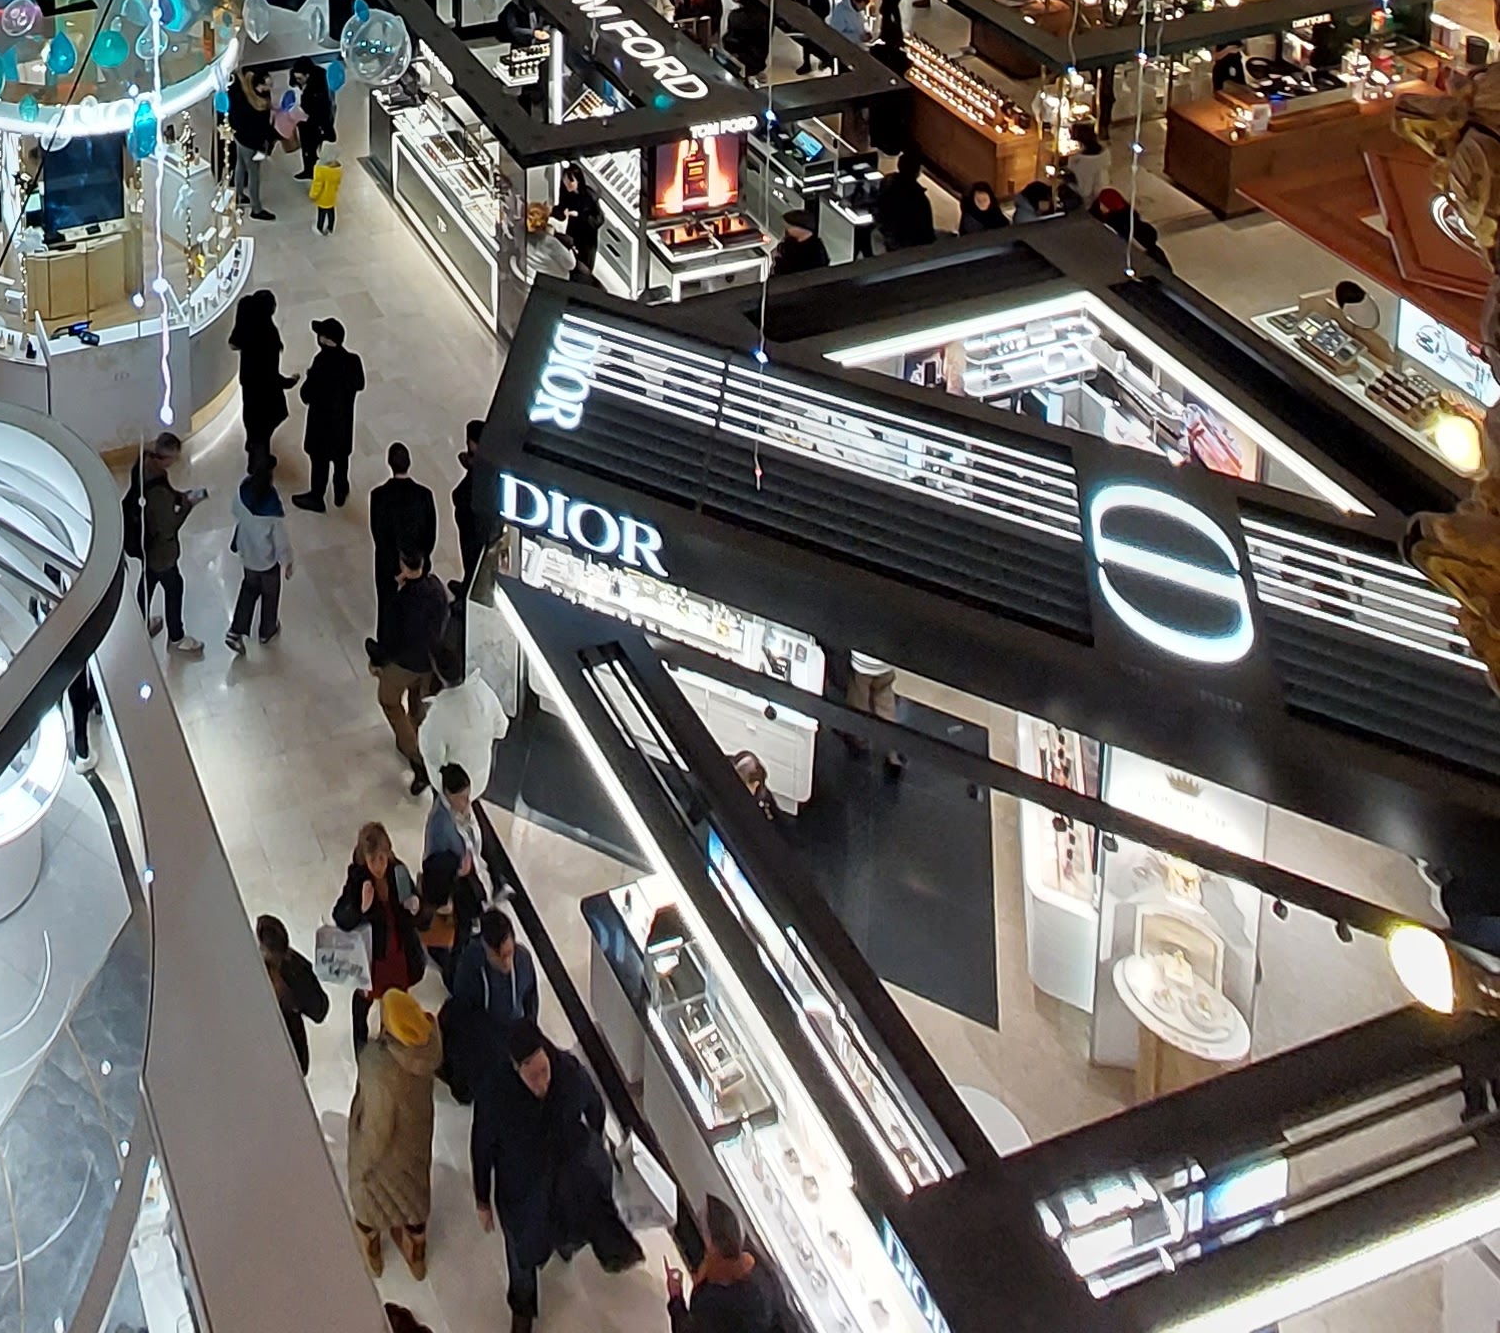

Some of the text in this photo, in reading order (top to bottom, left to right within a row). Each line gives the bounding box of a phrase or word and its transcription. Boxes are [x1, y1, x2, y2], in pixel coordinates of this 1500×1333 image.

[600, 19, 709, 99] FORD
[690, 115, 758, 139] TOM FORD
[529, 321, 602, 430] DIOR
[499, 473, 669, 578] DIOR
